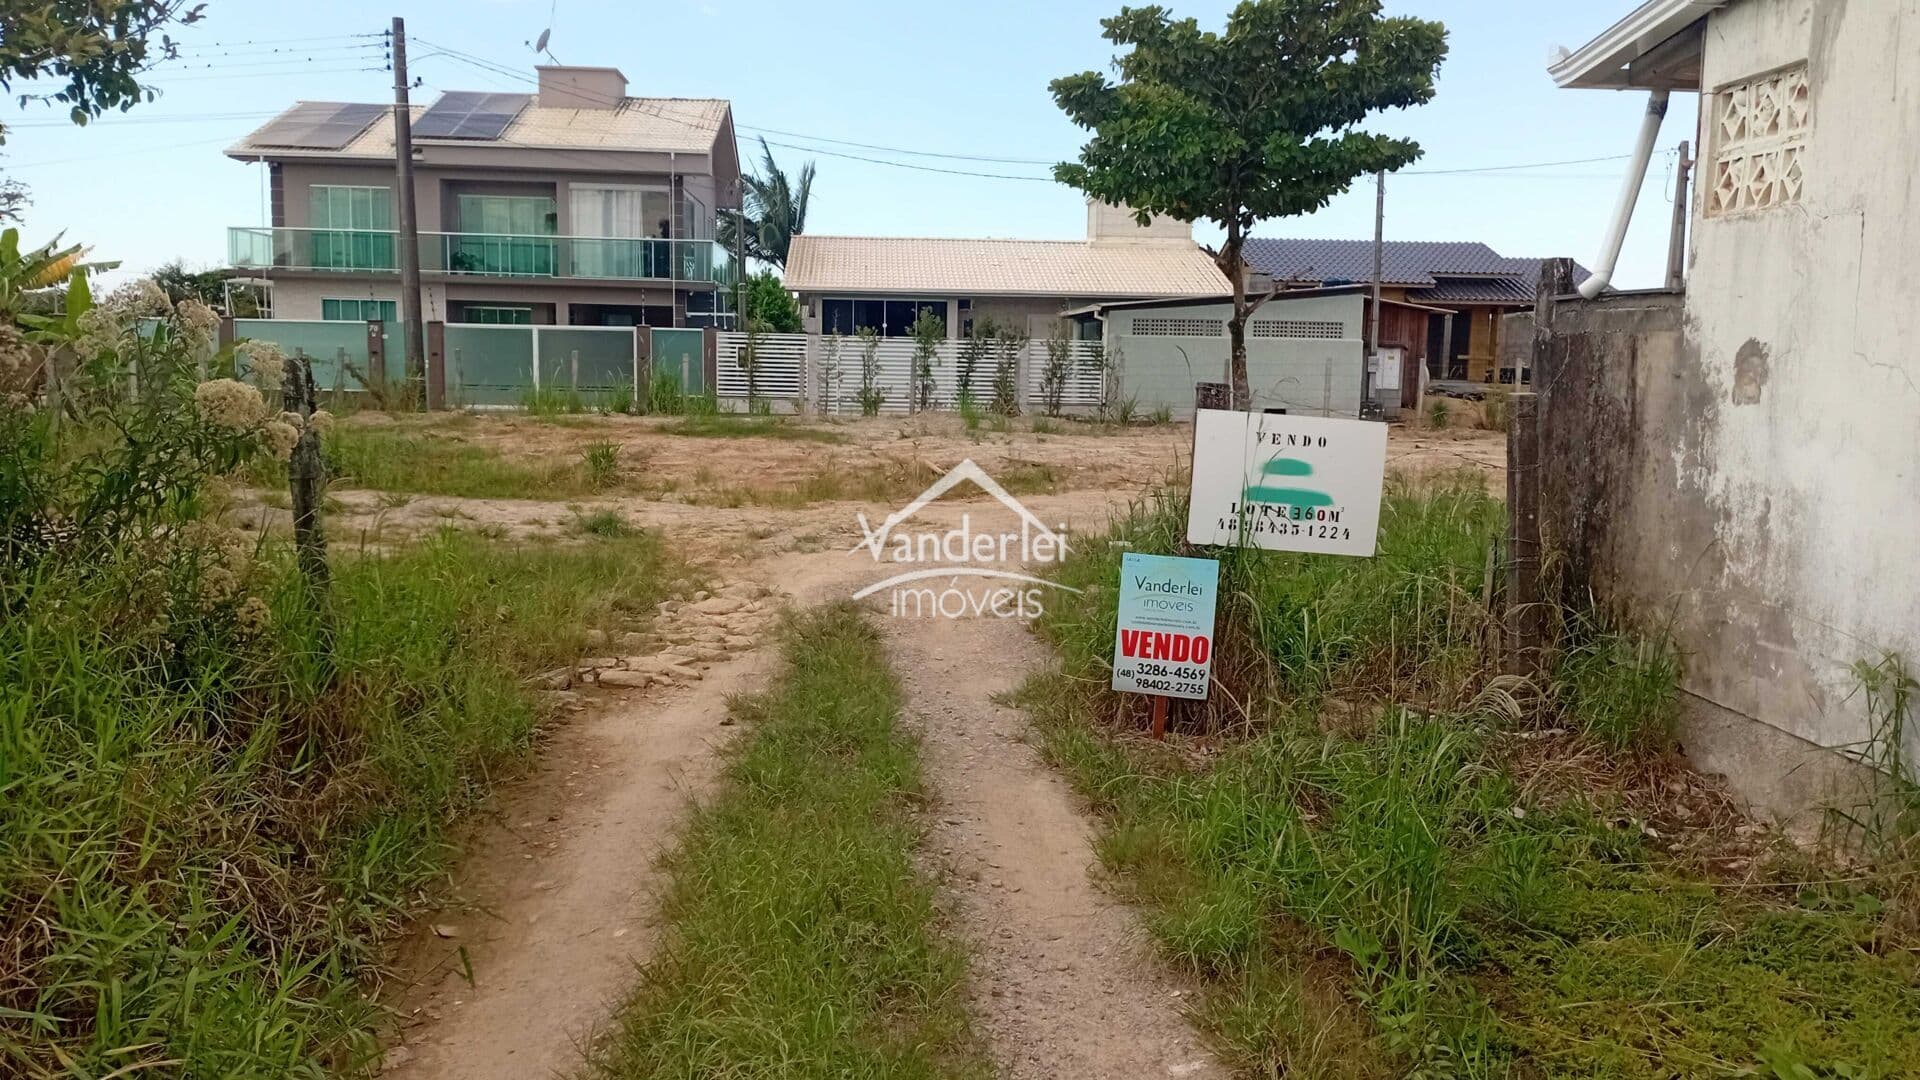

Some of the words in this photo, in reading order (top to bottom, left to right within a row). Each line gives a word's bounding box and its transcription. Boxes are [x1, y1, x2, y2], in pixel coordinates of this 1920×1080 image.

[1256, 431, 1327, 448] VENDO
[1135, 575, 1203, 596] Vanderlei
[1121, 629, 1209, 665] VENDO
[1116, 667, 1135, 680] (48)
[1136, 662, 1206, 681] 3286-4569
[1135, 677, 1204, 694] 98402-2755
